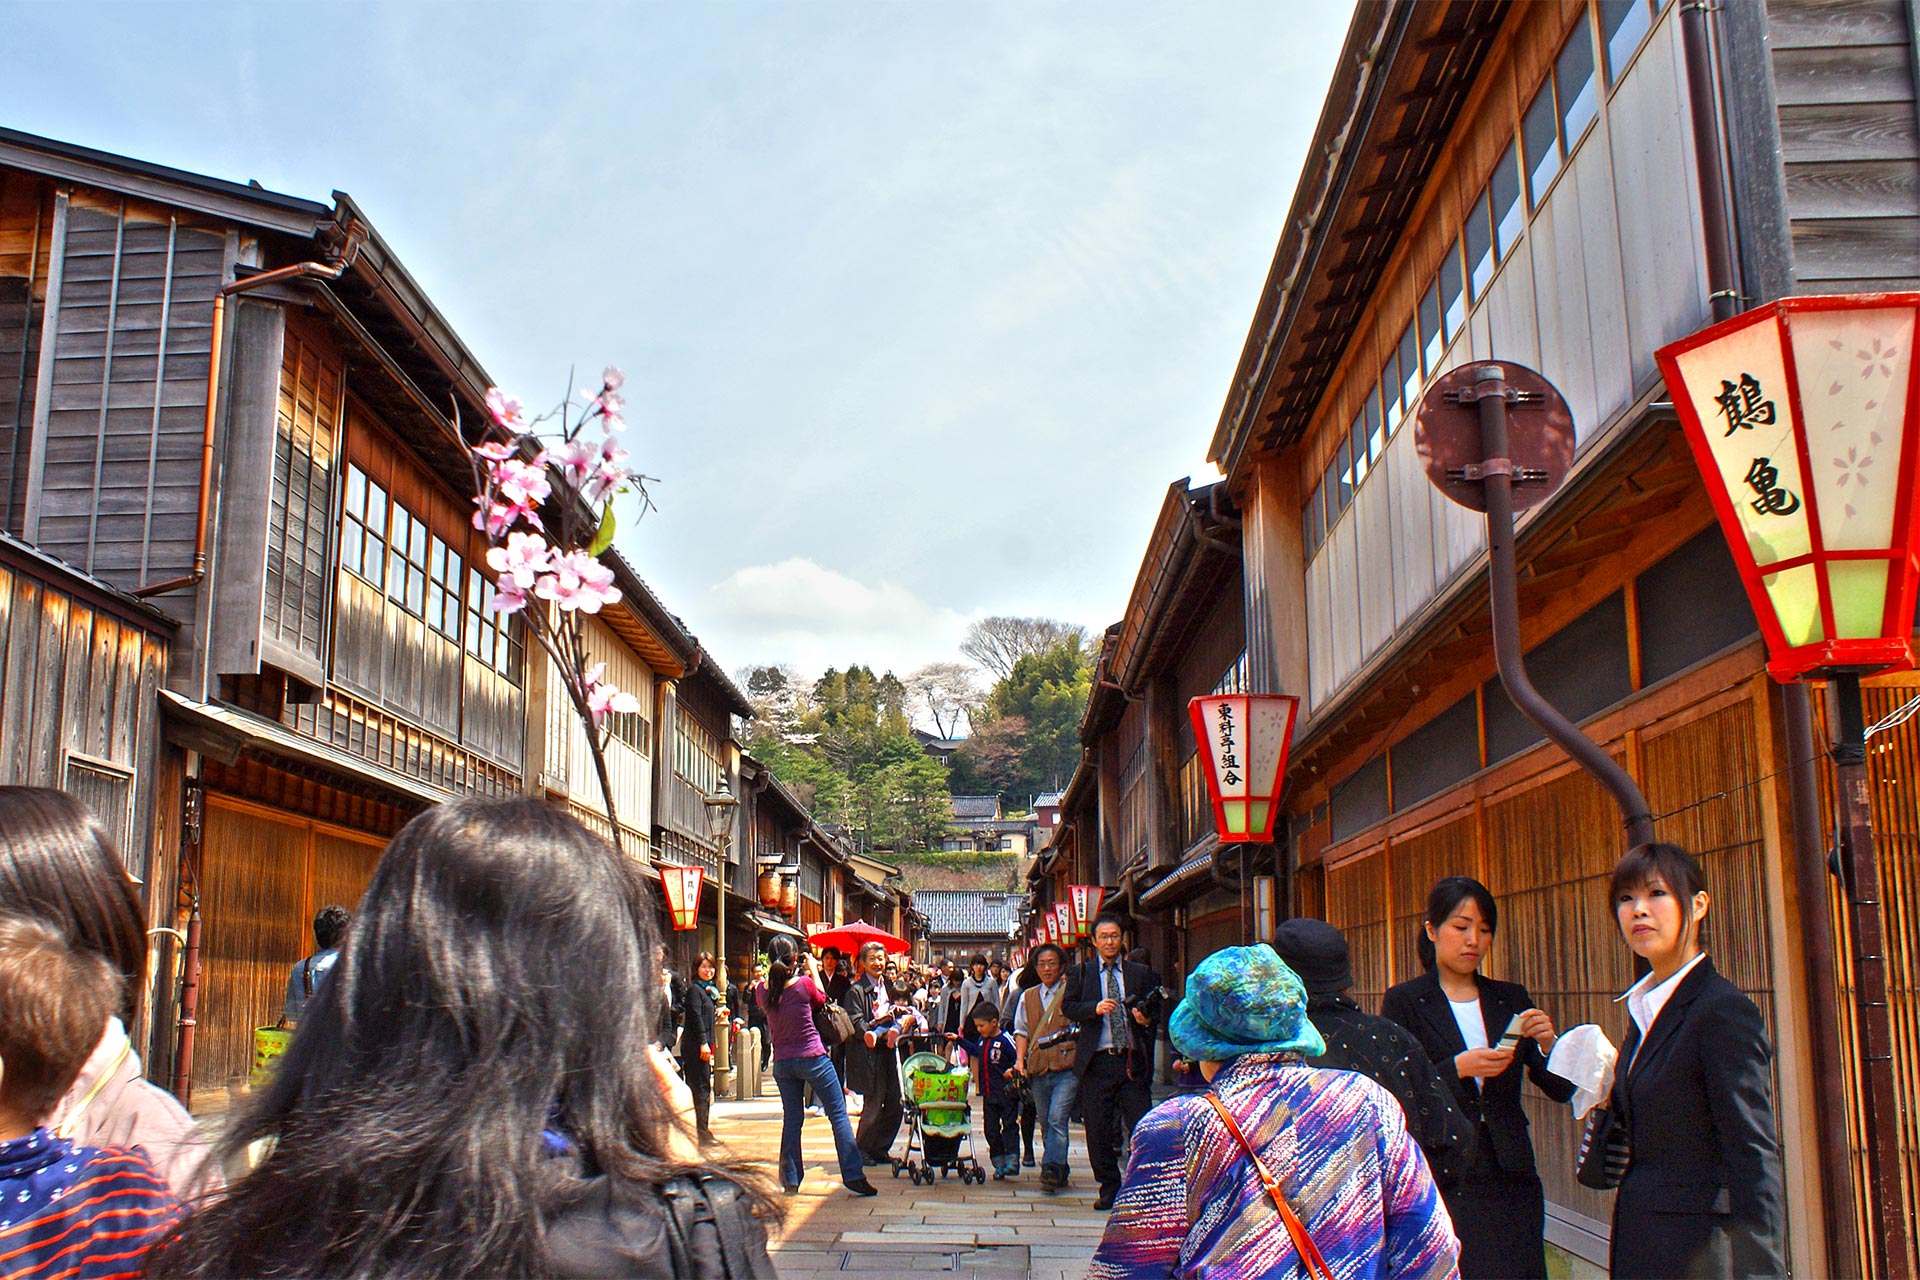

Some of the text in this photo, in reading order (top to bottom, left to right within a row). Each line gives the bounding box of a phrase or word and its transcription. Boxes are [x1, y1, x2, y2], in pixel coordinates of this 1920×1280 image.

[1715, 372, 1800, 516] 鶴亀
[1218, 702, 1243, 786] 東料亭組合
